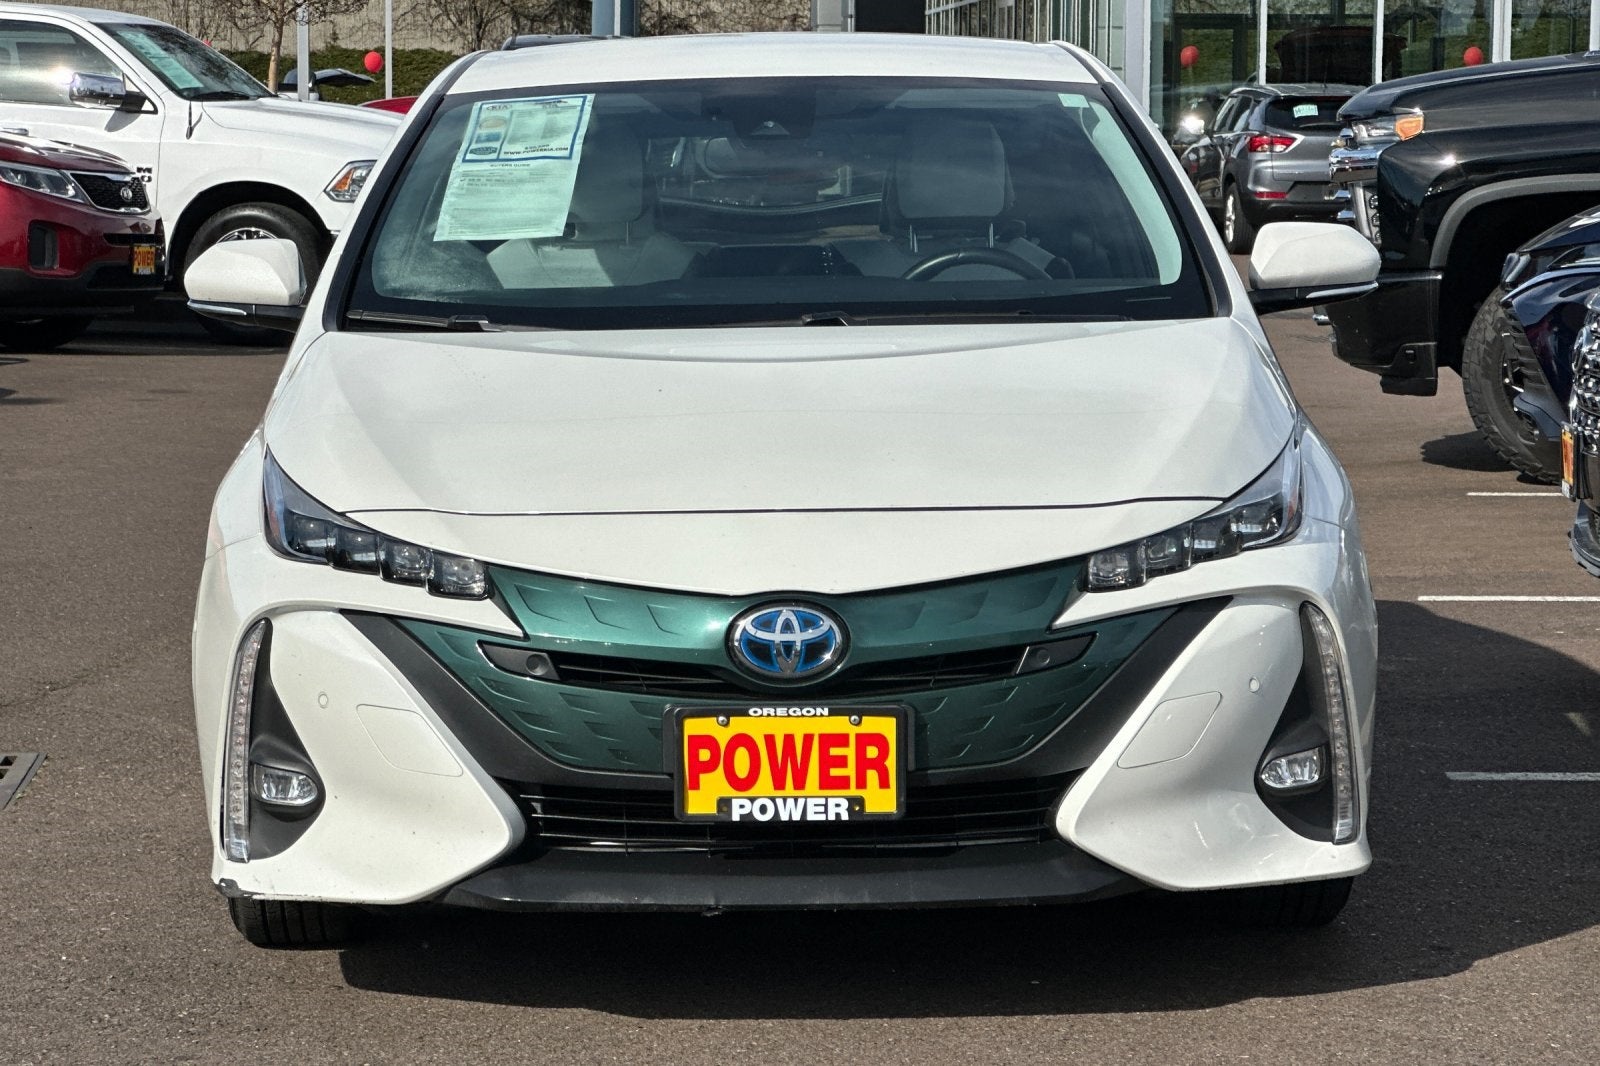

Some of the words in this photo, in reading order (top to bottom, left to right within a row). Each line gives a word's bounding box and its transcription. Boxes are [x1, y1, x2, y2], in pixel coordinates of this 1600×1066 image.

[134, 250, 154, 265] POWER
[748, 707, 829, 717] OREGON
[687, 732, 891, 792] POWER
[731, 797, 849, 822] POWER
